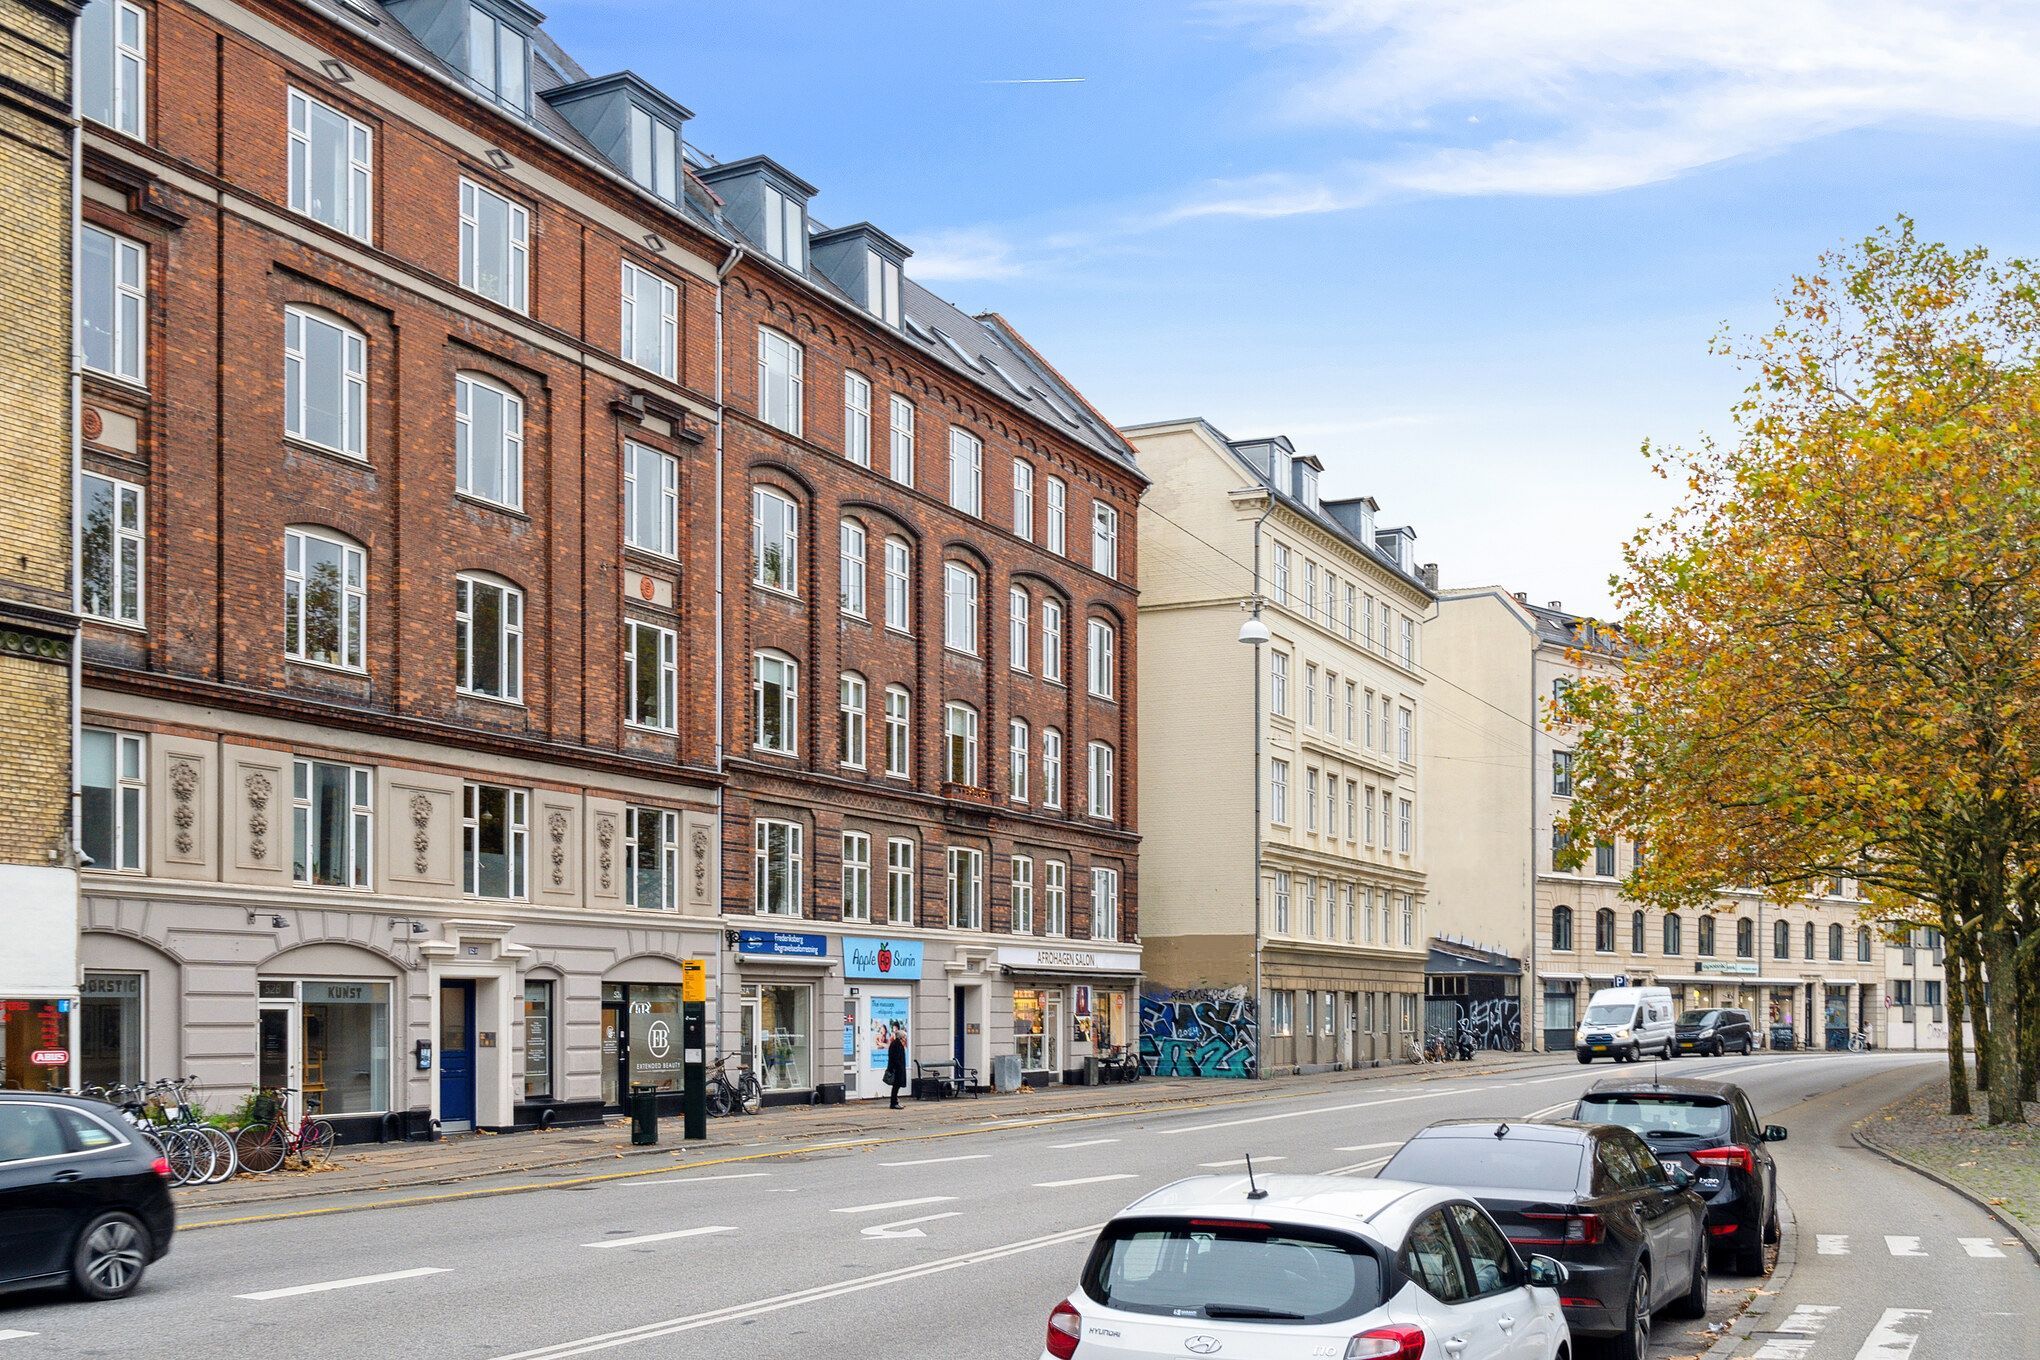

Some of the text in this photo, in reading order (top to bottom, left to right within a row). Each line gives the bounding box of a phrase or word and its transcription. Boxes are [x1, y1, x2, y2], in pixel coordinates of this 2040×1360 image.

[774, 933, 804, 944] Frederiksberg
[852, 948, 916, 971] Apple Surin
[1037, 951, 1095, 966] AFROHAGEN SALON
[1616, 976, 1623, 987] P
[328, 986, 362, 998] KUNST
[36, 1053, 65, 1061] ABUS
[636, 1061, 681, 1070] EXTENDED BEAUTY
[1089, 1327, 1121, 1338] HYUNDAI
